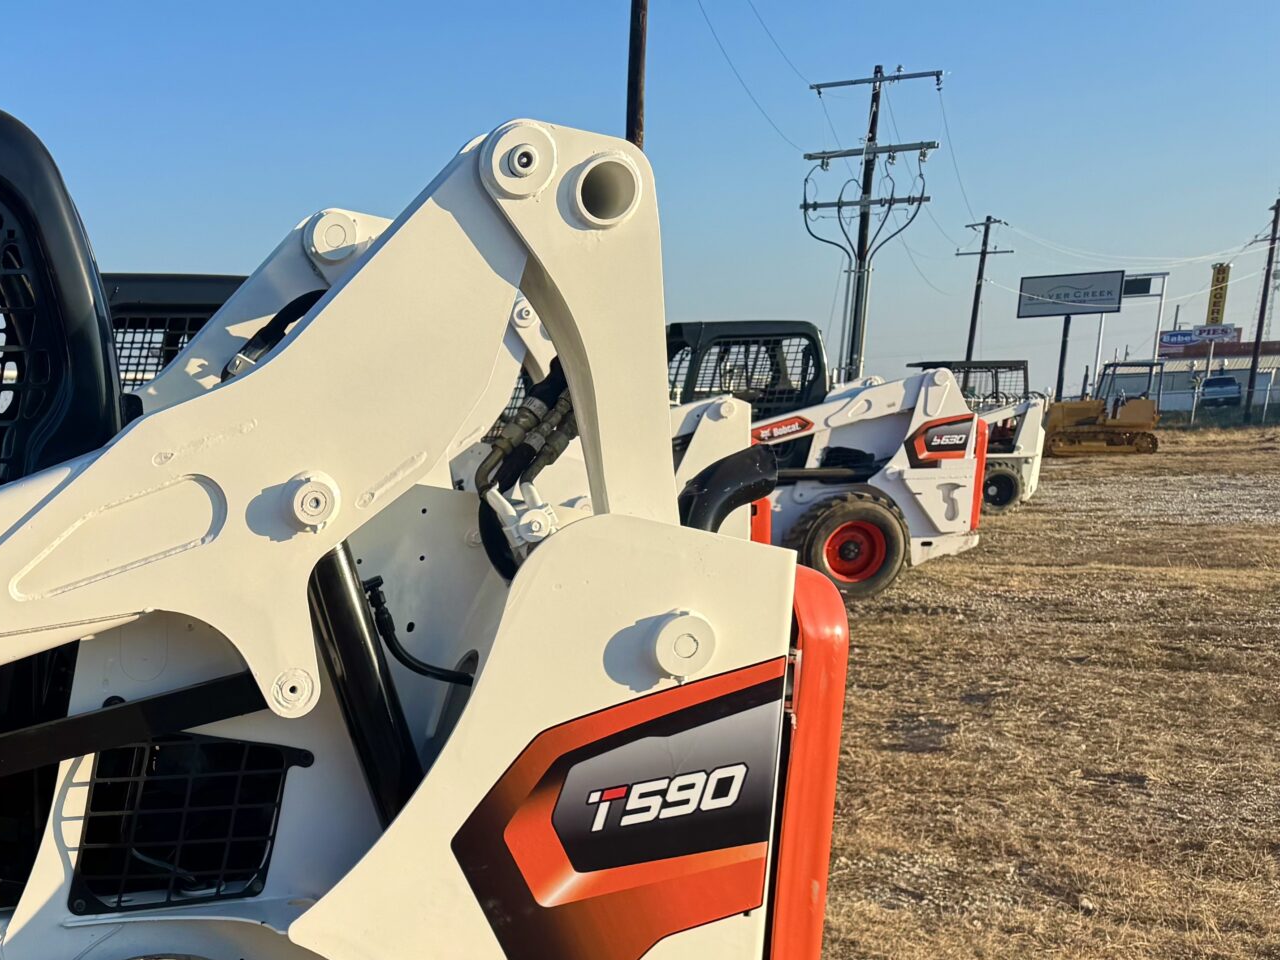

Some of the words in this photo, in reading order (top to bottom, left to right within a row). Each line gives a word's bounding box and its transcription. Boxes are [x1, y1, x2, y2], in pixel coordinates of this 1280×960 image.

[1210, 268, 1226, 324] BURGERS
[1198, 327, 1228, 336] PIES
[930, 434, 966, 446] S630
[587, 764, 748, 832] T590
